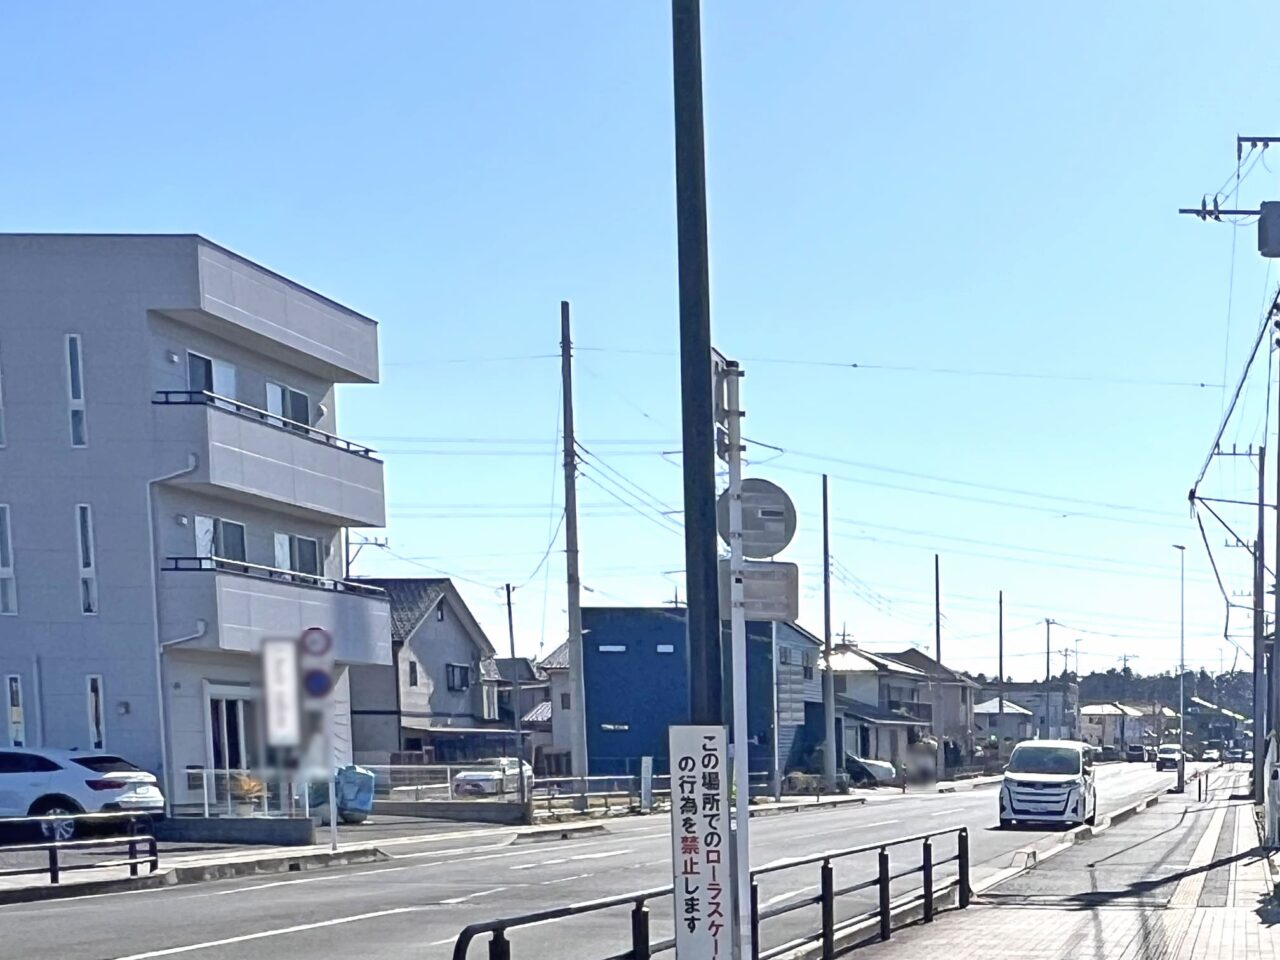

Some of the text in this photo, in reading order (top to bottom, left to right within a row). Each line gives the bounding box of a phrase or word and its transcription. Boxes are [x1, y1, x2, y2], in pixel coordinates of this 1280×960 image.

[678, 756, 702, 934] の行為を禁止します
